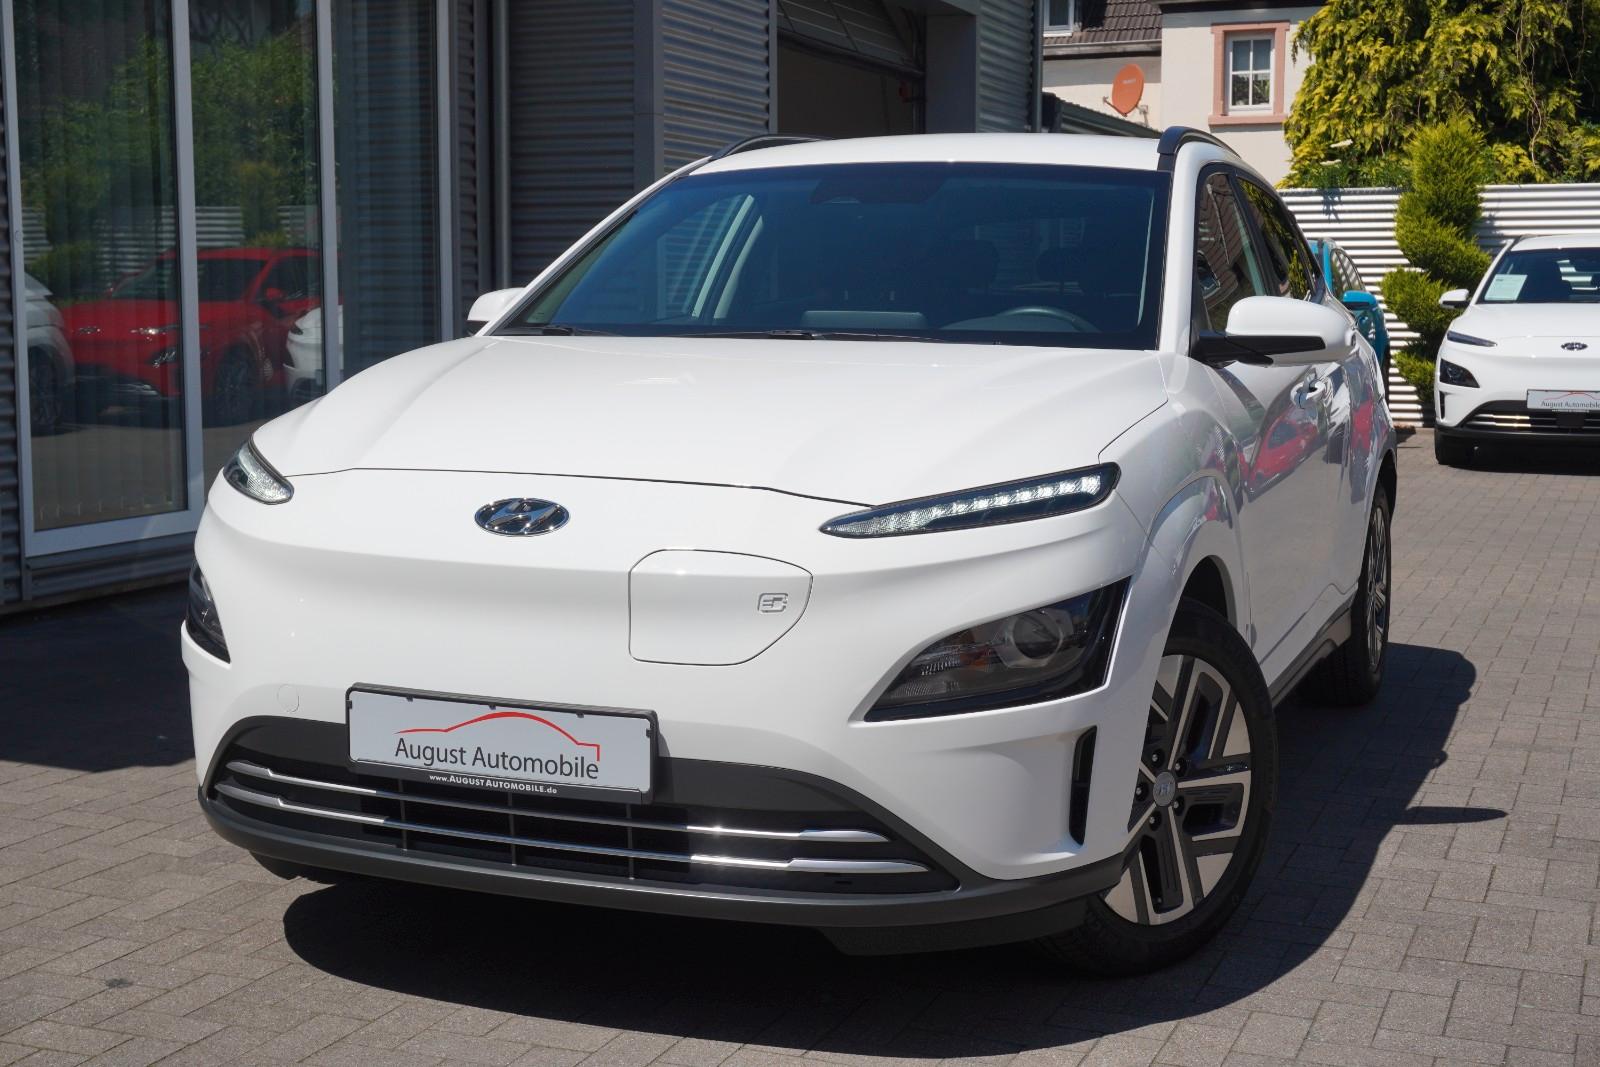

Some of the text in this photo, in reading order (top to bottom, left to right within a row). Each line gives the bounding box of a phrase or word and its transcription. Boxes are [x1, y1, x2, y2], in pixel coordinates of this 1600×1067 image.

[1541, 401, 1563, 409] August
[395, 737, 599, 779] August Automobile
